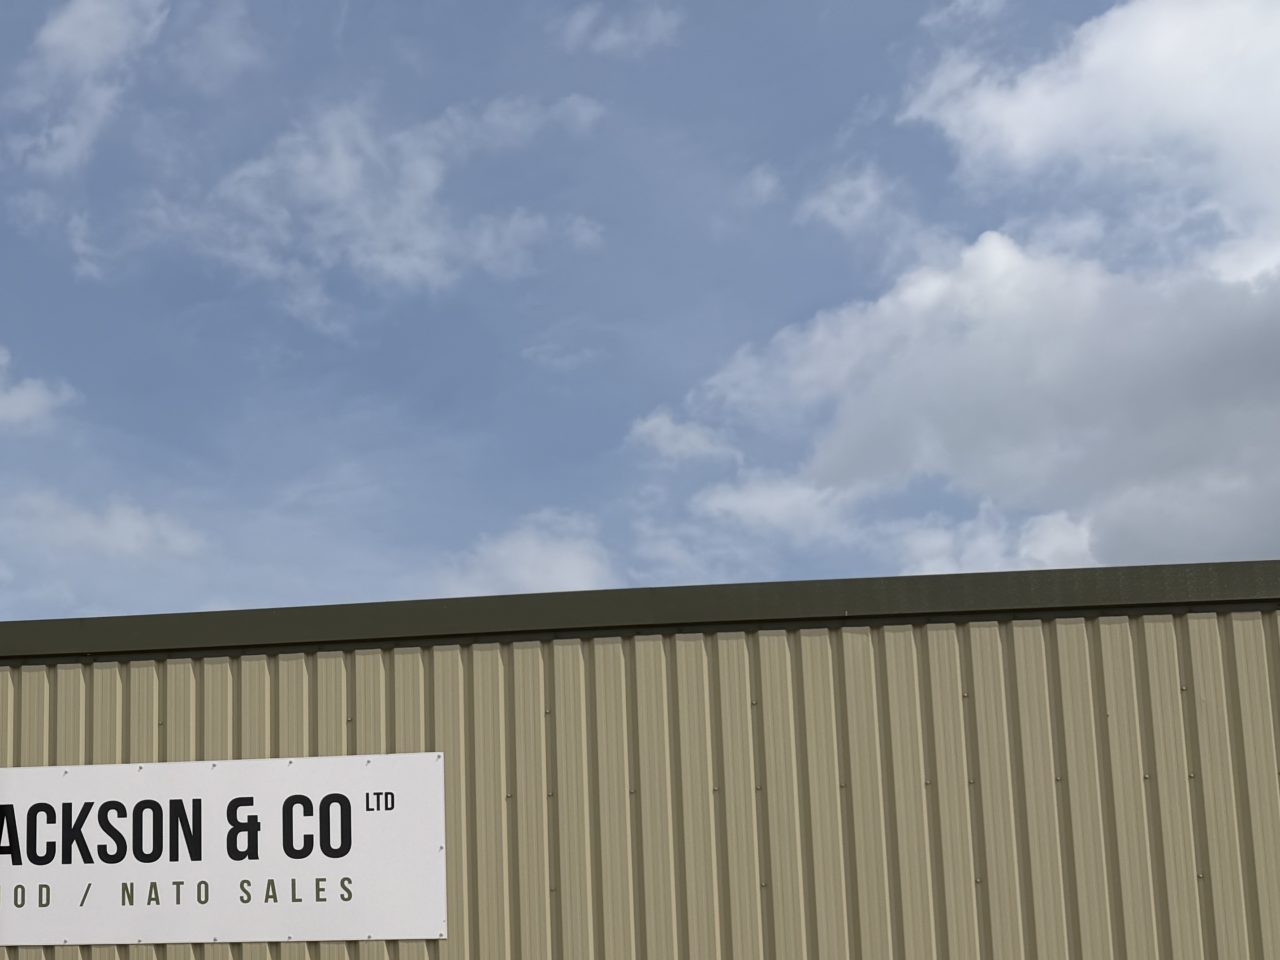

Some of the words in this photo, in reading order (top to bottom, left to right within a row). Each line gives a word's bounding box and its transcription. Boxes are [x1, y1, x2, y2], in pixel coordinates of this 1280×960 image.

[226, 796, 262, 862] &
[281, 792, 353, 860] CO
[365, 791, 395, 812] LTD
[79, 882, 92, 907] /
[121, 880, 210, 907] NATO
[239, 876, 353, 904] SALES
